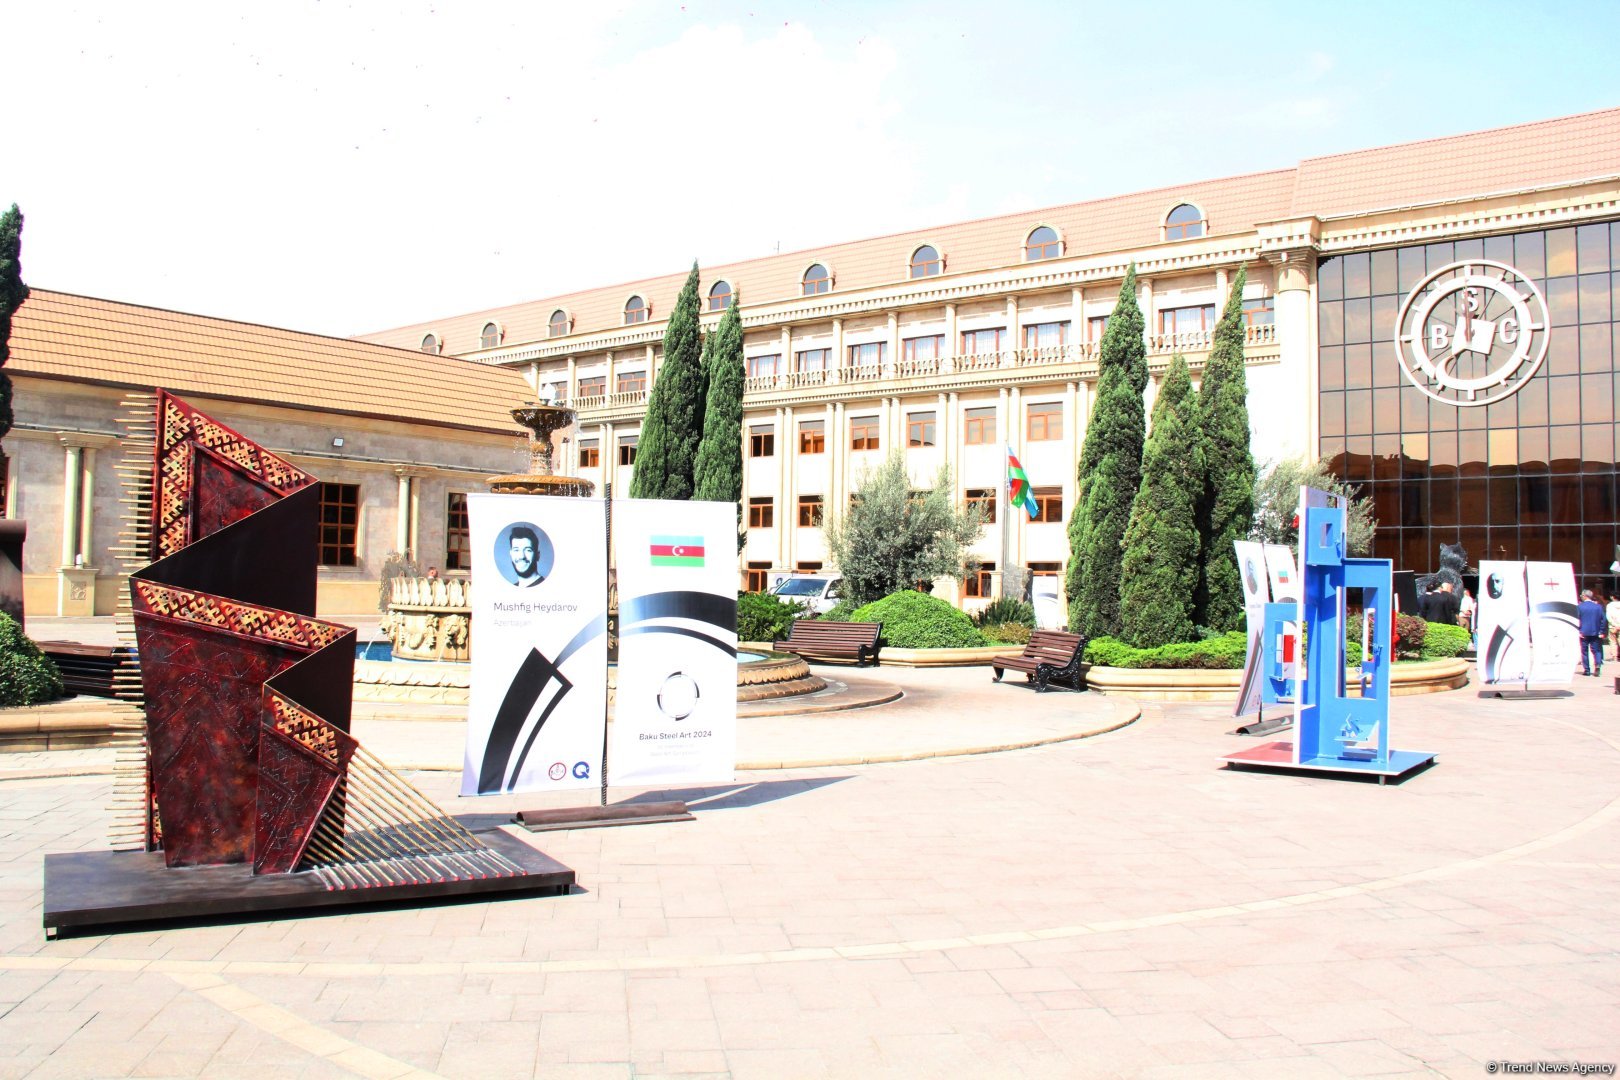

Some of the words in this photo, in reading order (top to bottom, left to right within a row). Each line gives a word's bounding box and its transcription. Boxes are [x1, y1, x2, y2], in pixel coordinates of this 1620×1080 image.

[1462, 287, 1479, 313] S
[493, 602, 531, 613] Mushfig
[533, 602, 578, 613] Heydarov
[639, 733, 658, 741] Baku
[659, 732, 678, 740] Steel
[679, 731, 692, 739] Art
[693, 730, 712, 738] 2024
